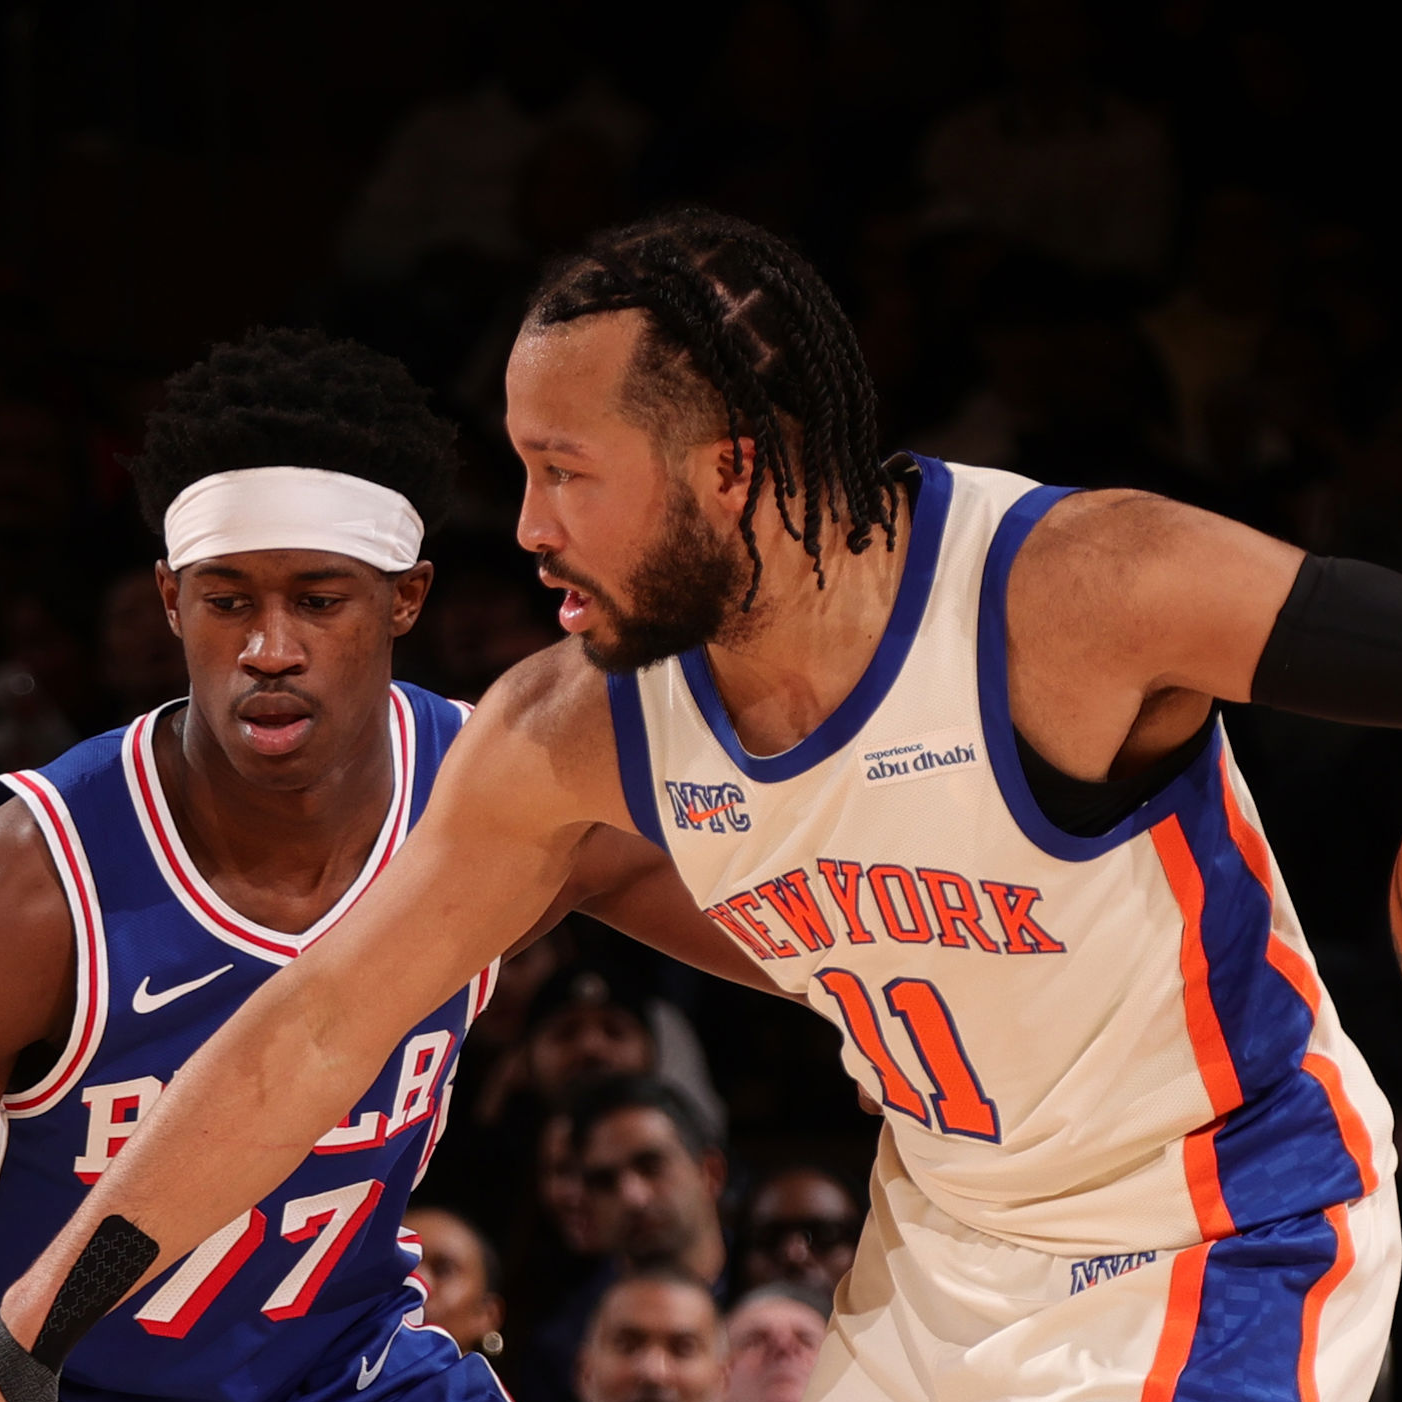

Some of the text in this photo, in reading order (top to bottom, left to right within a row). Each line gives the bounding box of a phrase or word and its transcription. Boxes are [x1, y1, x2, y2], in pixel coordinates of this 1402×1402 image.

[864, 743, 924, 761] experience
[866, 759, 910, 781] abu
[665, 780, 751, 833] NYC
[703, 857, 1068, 960] NEW YORK
[813, 966, 1002, 1145] 11
